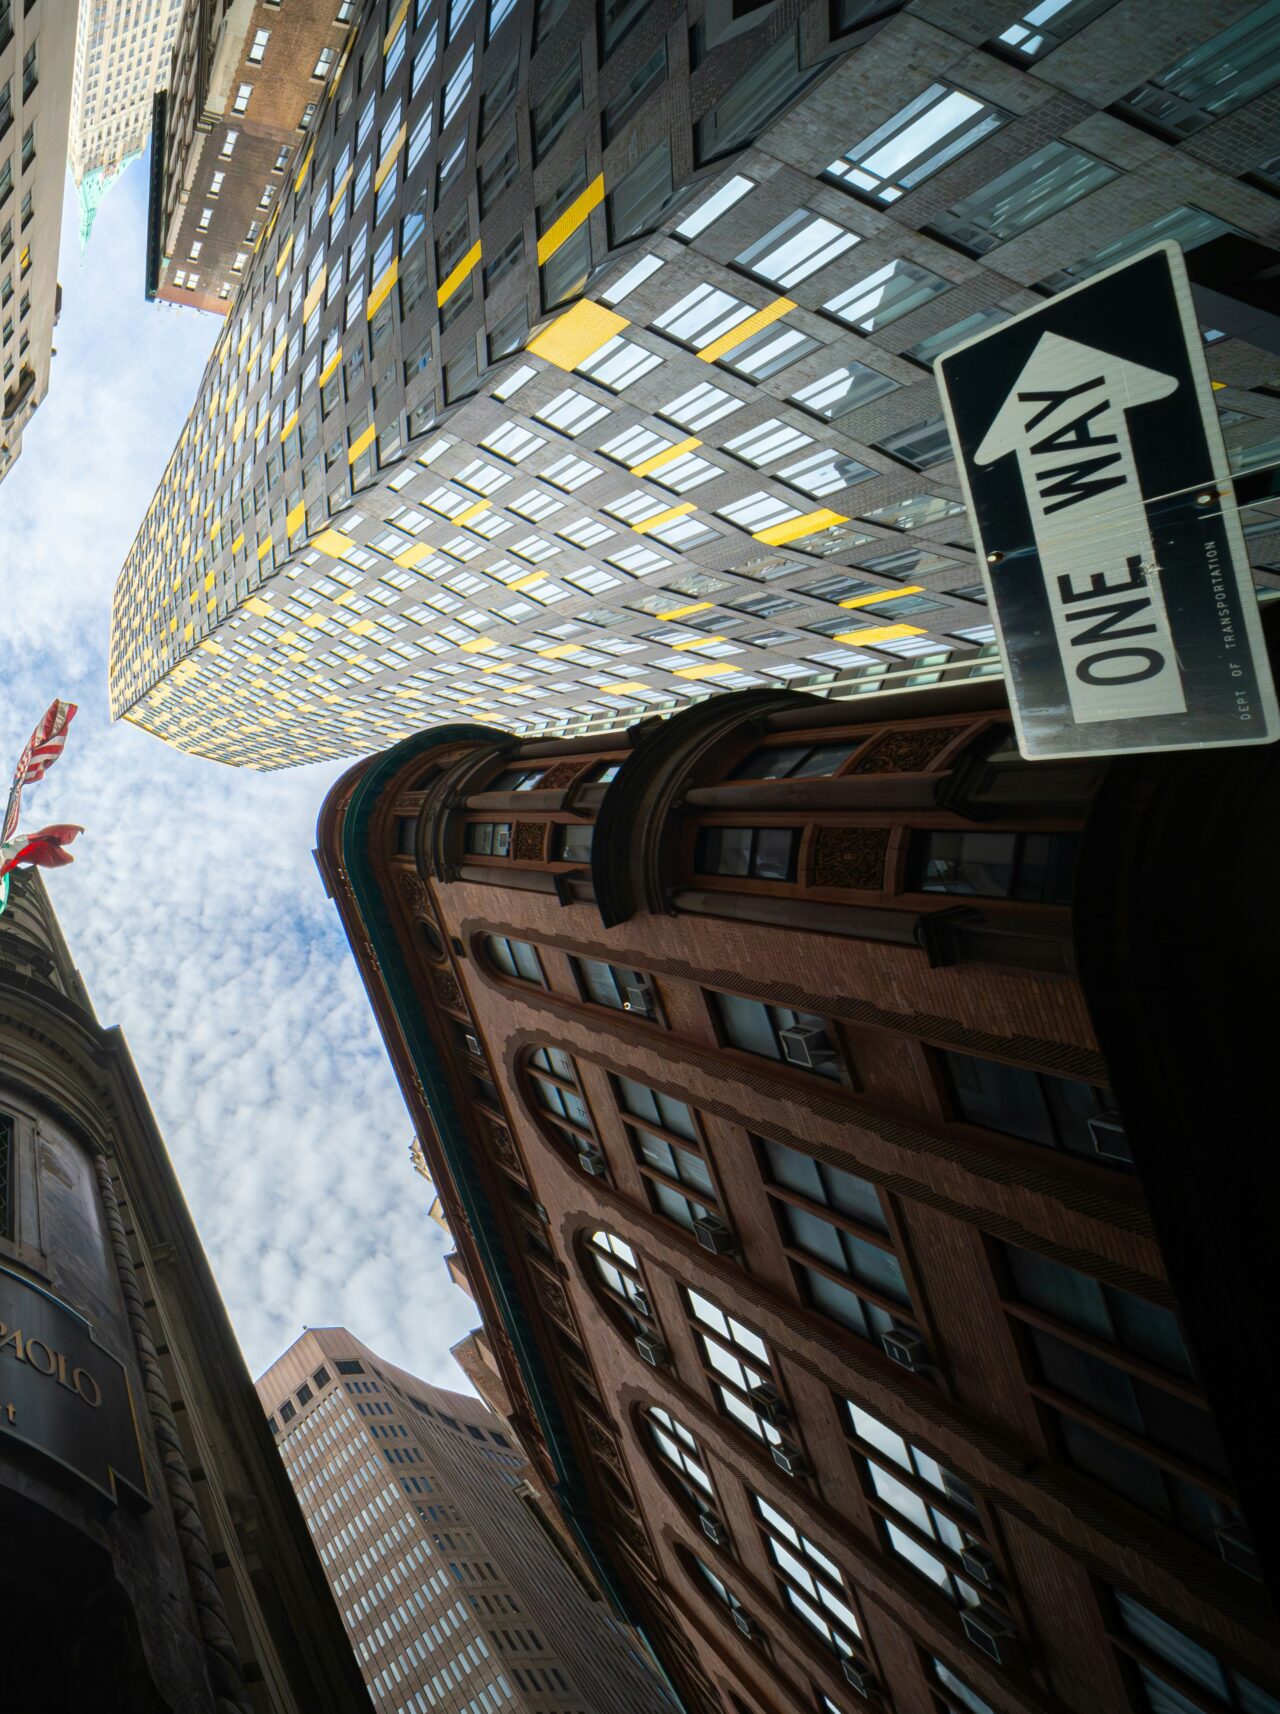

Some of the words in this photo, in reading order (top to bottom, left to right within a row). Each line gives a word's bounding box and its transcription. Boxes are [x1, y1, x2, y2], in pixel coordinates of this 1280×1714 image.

[1017, 375, 1127, 516] WAY
[1057, 555, 1166, 687] ONE
[1204, 540, 1236, 649] TRANSPORTATION
[1229, 662, 1241, 678] OF
[1236, 690, 1252, 720] DEPT
